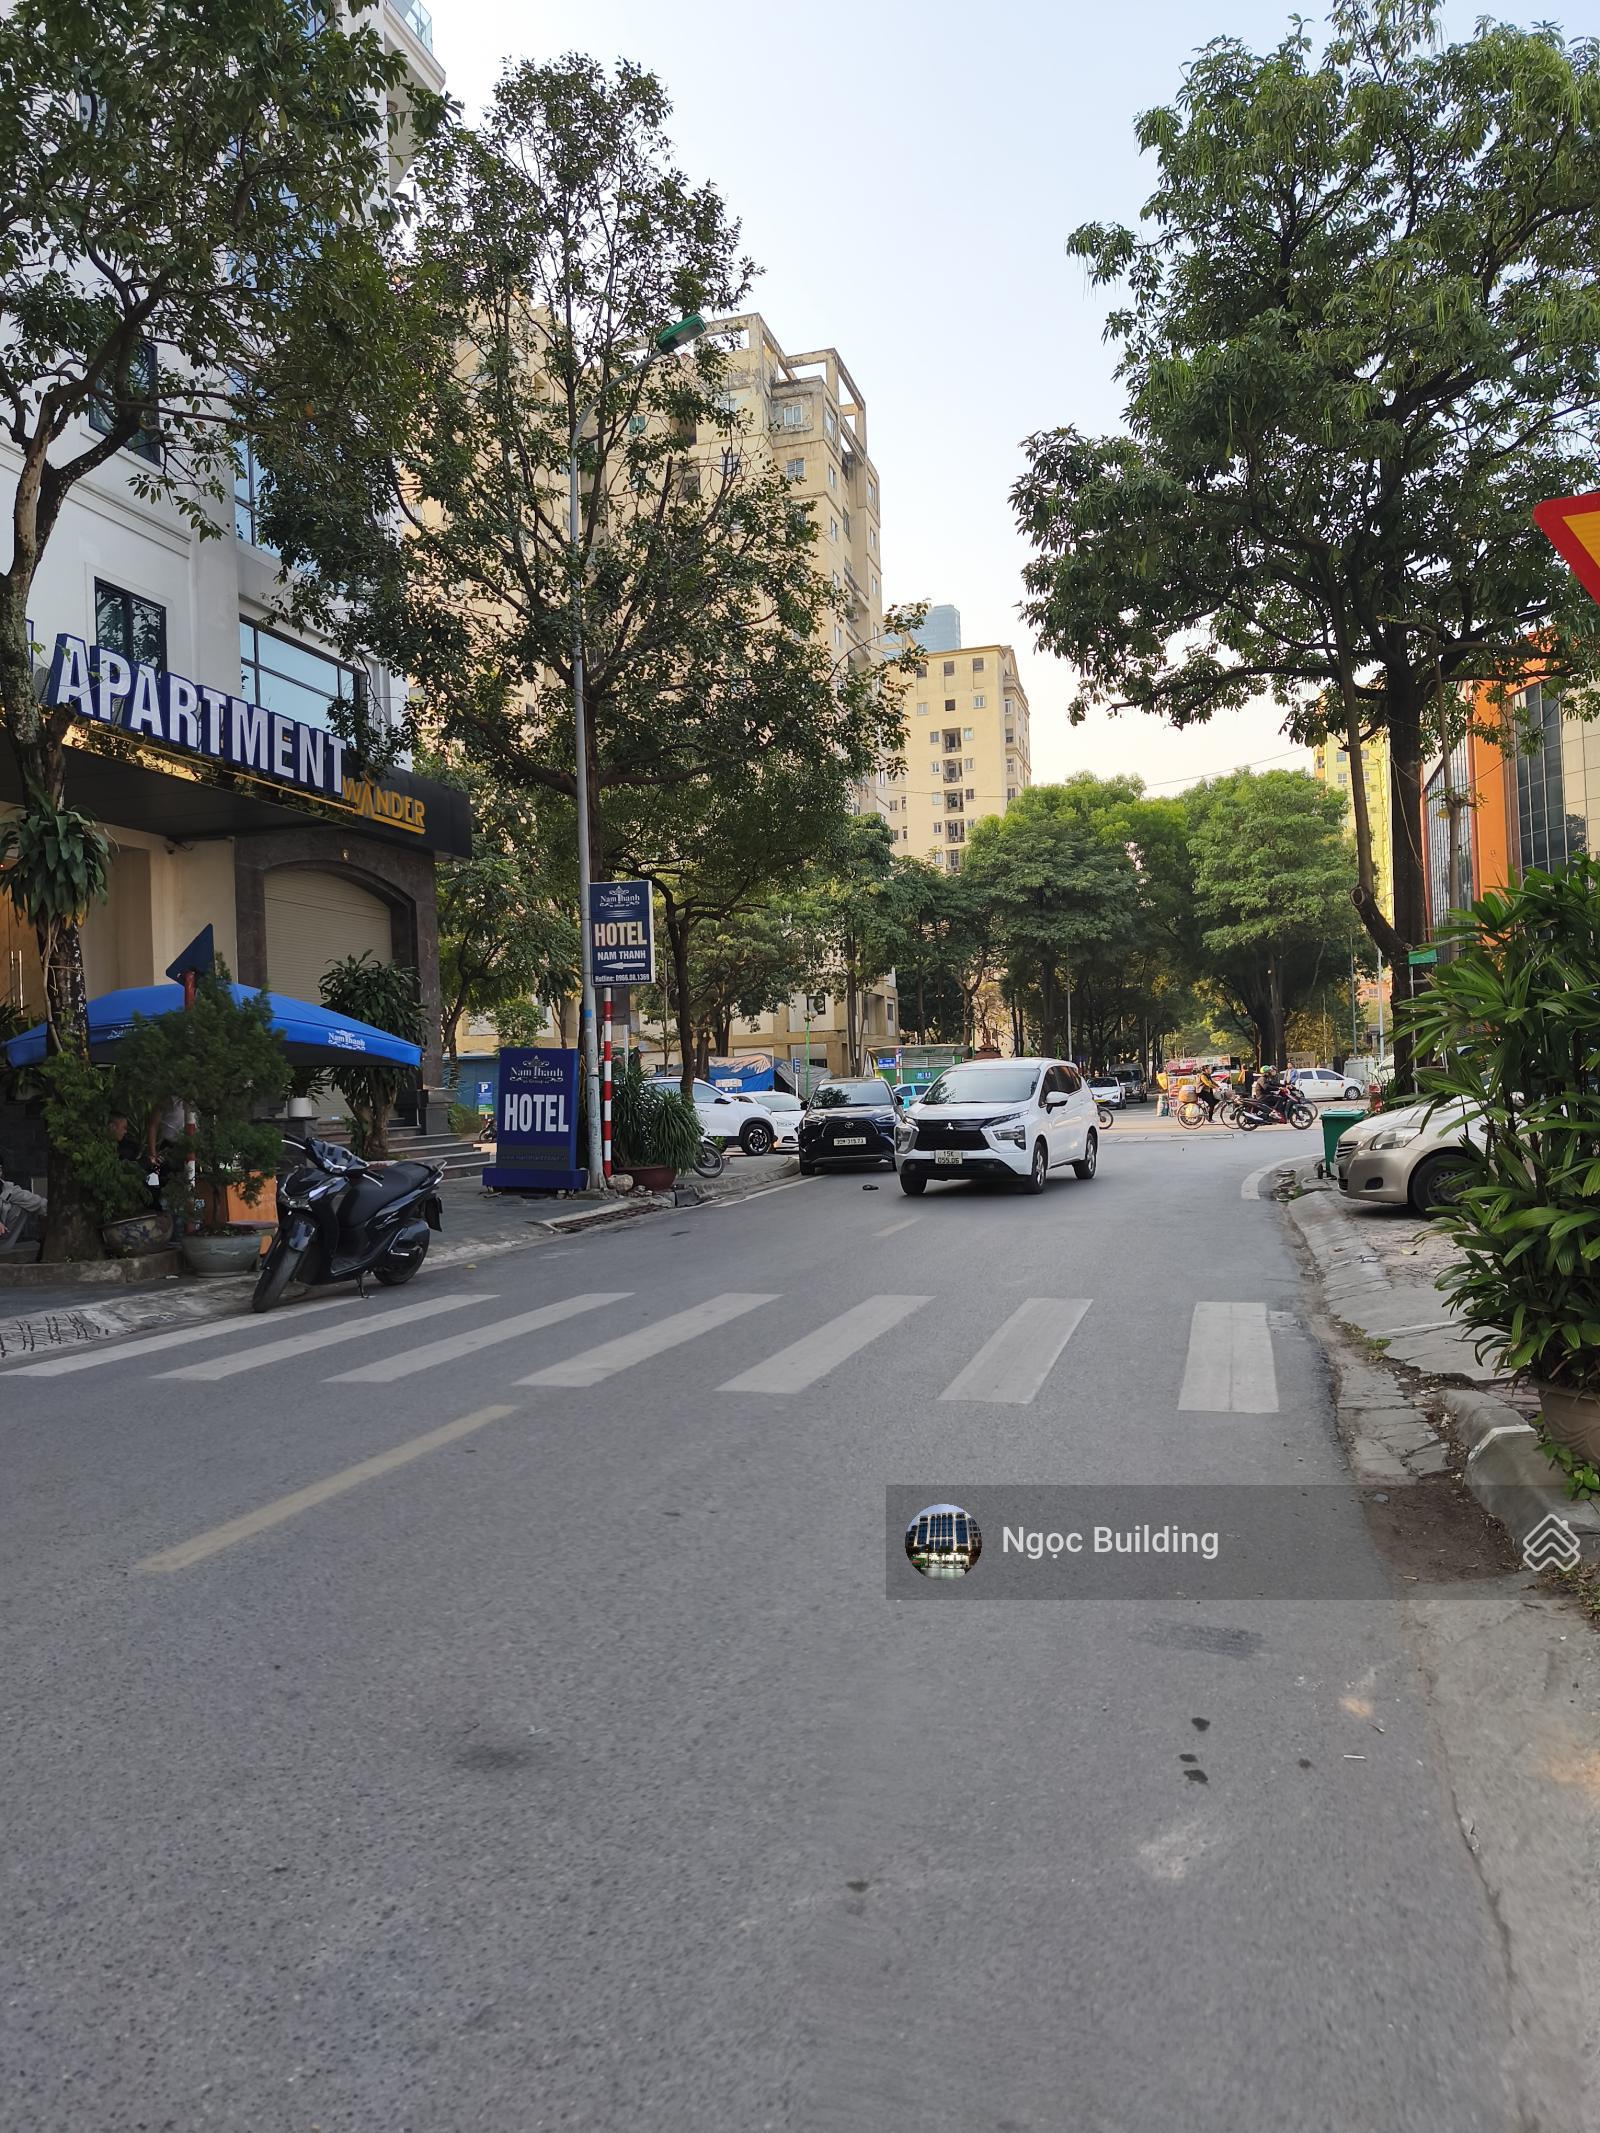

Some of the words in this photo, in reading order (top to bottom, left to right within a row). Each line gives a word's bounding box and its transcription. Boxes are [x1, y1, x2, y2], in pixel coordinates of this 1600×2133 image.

[52, 633, 347, 793] APARTMENT
[342, 775, 425, 827] WANDER
[600, 895, 617, 903] Nam
[594, 921, 648, 947] HOTEL
[597, 951, 617, 961] NAM
[619, 949, 646, 960] THANH
[511, 1067, 532, 1077] Nam
[504, 1093, 569, 1132] HOTEL
